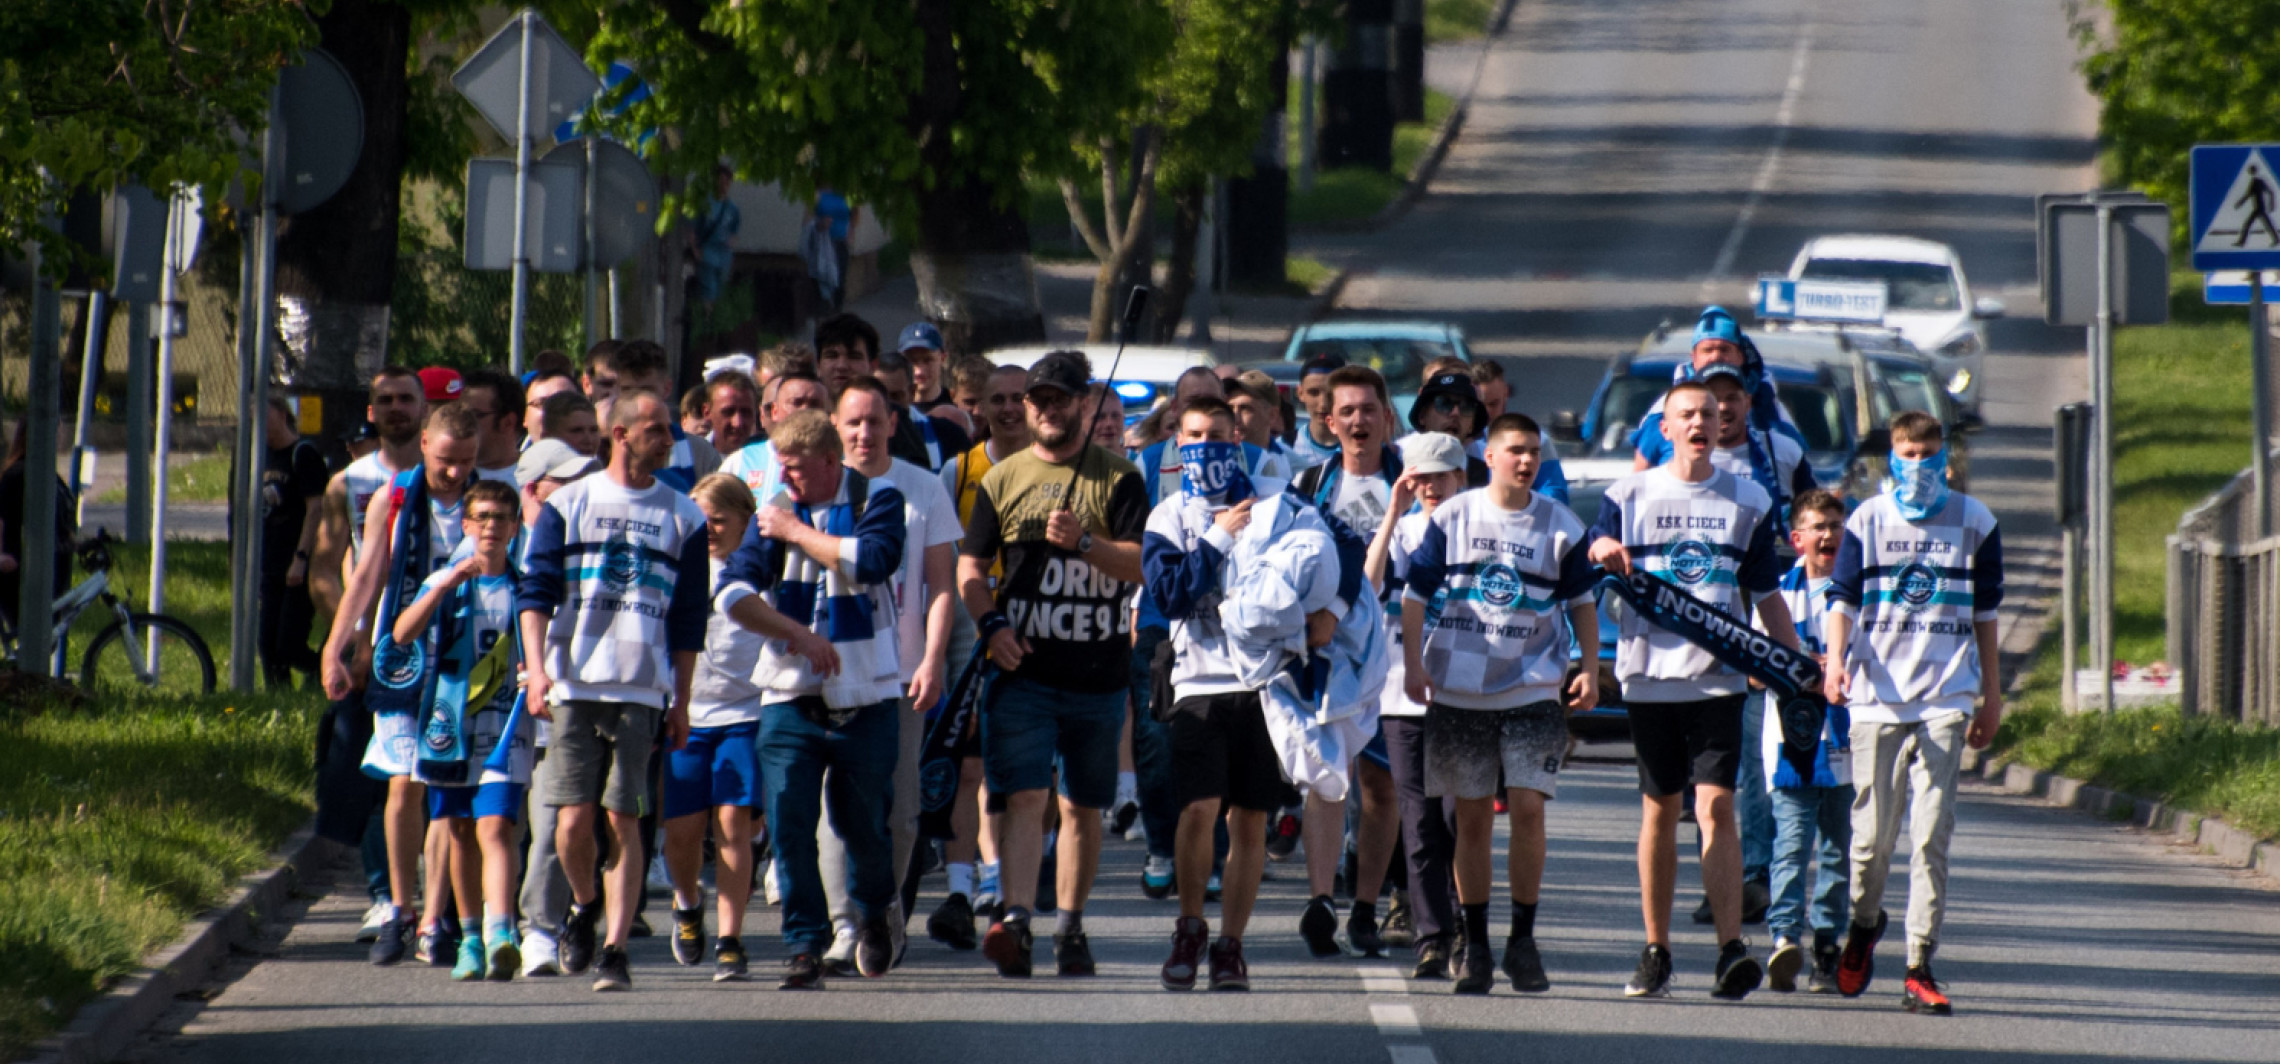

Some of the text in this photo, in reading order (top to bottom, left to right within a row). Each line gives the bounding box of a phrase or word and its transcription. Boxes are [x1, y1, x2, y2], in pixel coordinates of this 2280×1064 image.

[1765, 282, 1790, 313] L
[596, 517, 662, 536] KSK CIECH
[1656, 516, 1727, 530] KSK CIECH
[1472, 537, 1535, 560] KSK CIECH
[1886, 540, 1952, 553] KSK CIECH
[1039, 557, 1131, 598] ORIG
